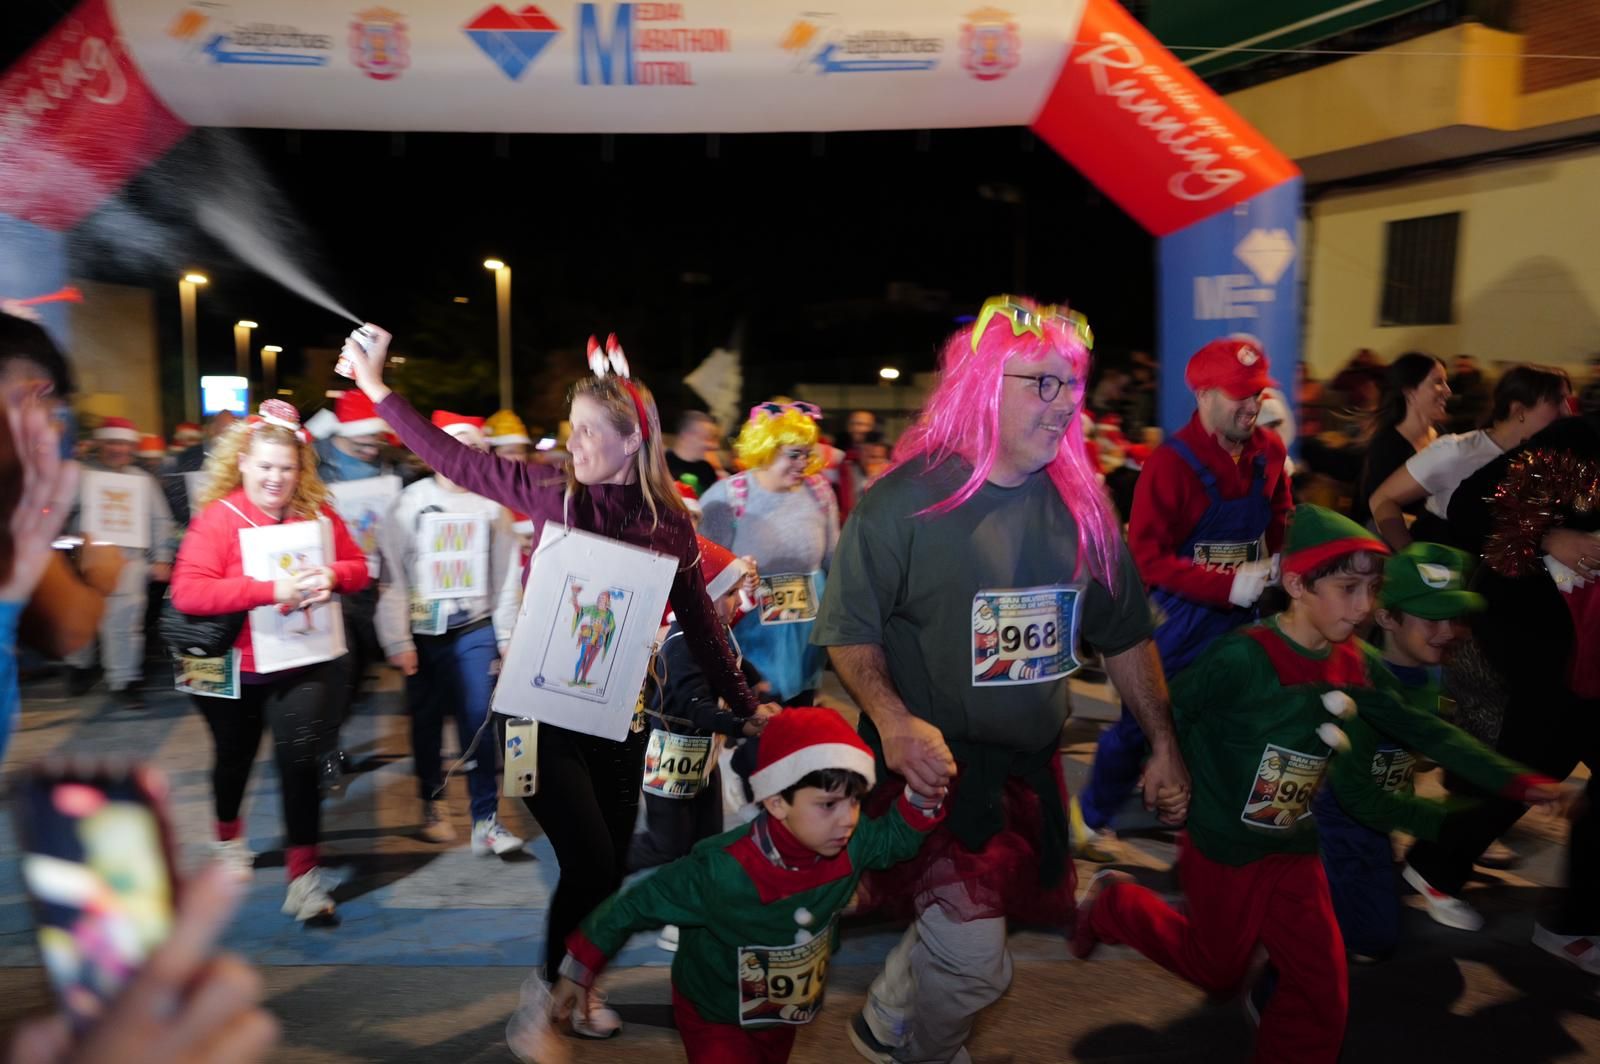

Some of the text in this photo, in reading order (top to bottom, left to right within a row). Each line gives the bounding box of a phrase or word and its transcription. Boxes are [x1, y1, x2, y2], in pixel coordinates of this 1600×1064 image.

[1074, 31, 1247, 201] Running
[1001, 621, 1057, 653] 968
[661, 757, 705, 775] 404
[1277, 780, 1315, 805] 96
